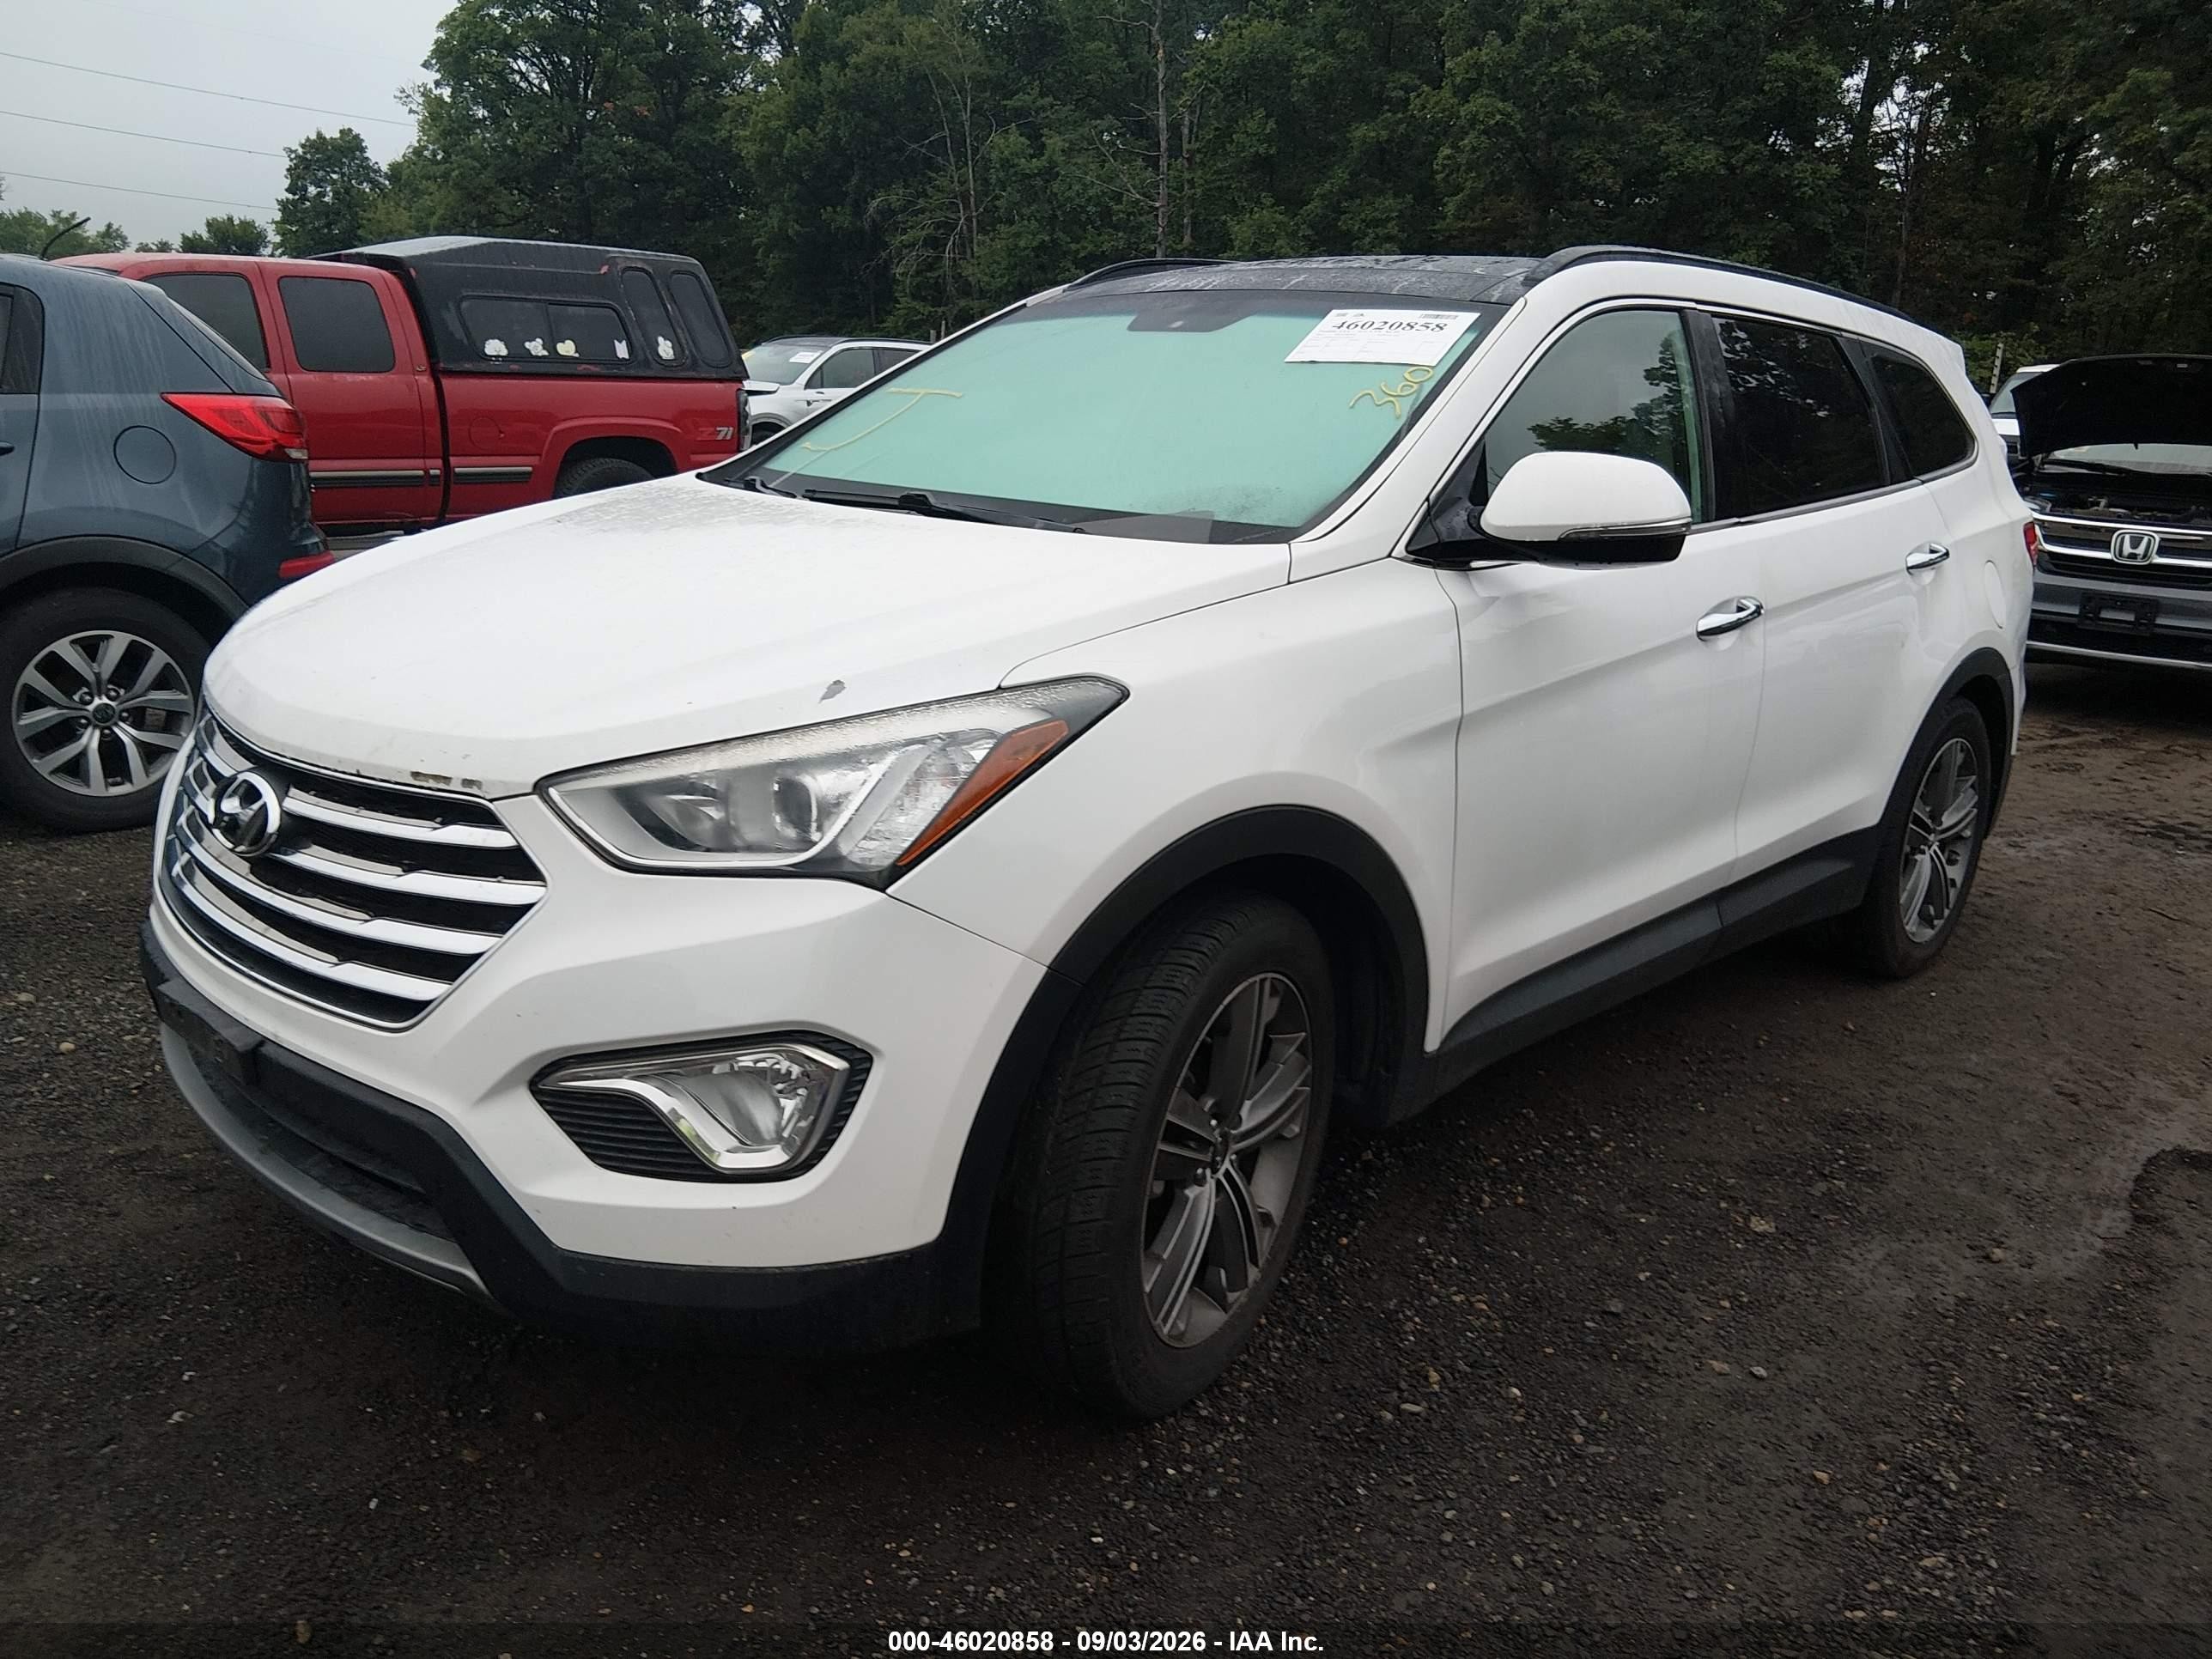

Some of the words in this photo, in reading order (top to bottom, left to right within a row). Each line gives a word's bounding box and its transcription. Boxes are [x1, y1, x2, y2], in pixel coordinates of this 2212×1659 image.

[1332, 320, 1448, 333] 46020858
[1348, 366, 1435, 419] 360
[696, 426, 734, 441] Z71
